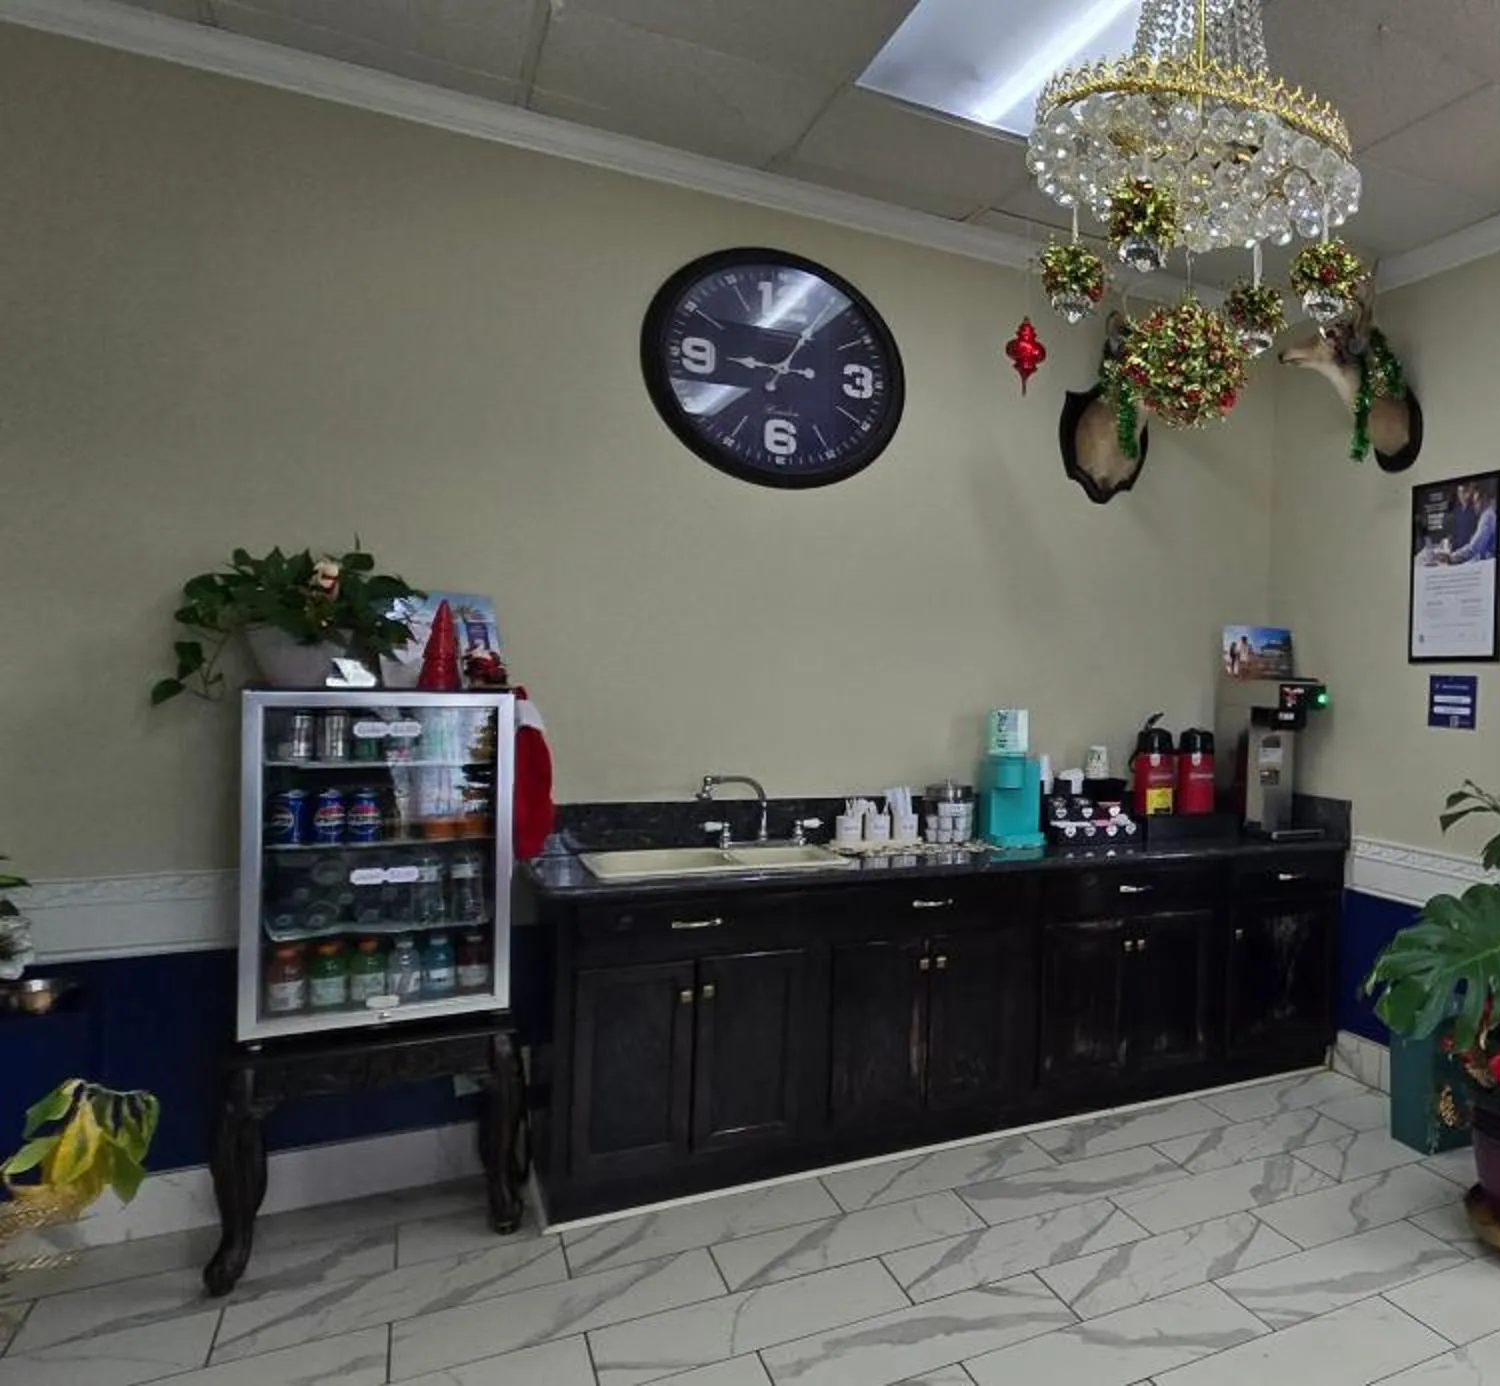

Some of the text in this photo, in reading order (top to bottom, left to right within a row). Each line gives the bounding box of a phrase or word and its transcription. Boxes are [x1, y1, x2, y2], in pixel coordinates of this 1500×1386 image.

[682, 337, 716, 374] 9
[843, 364, 873, 399] 3
[764, 419, 797, 455] 6
